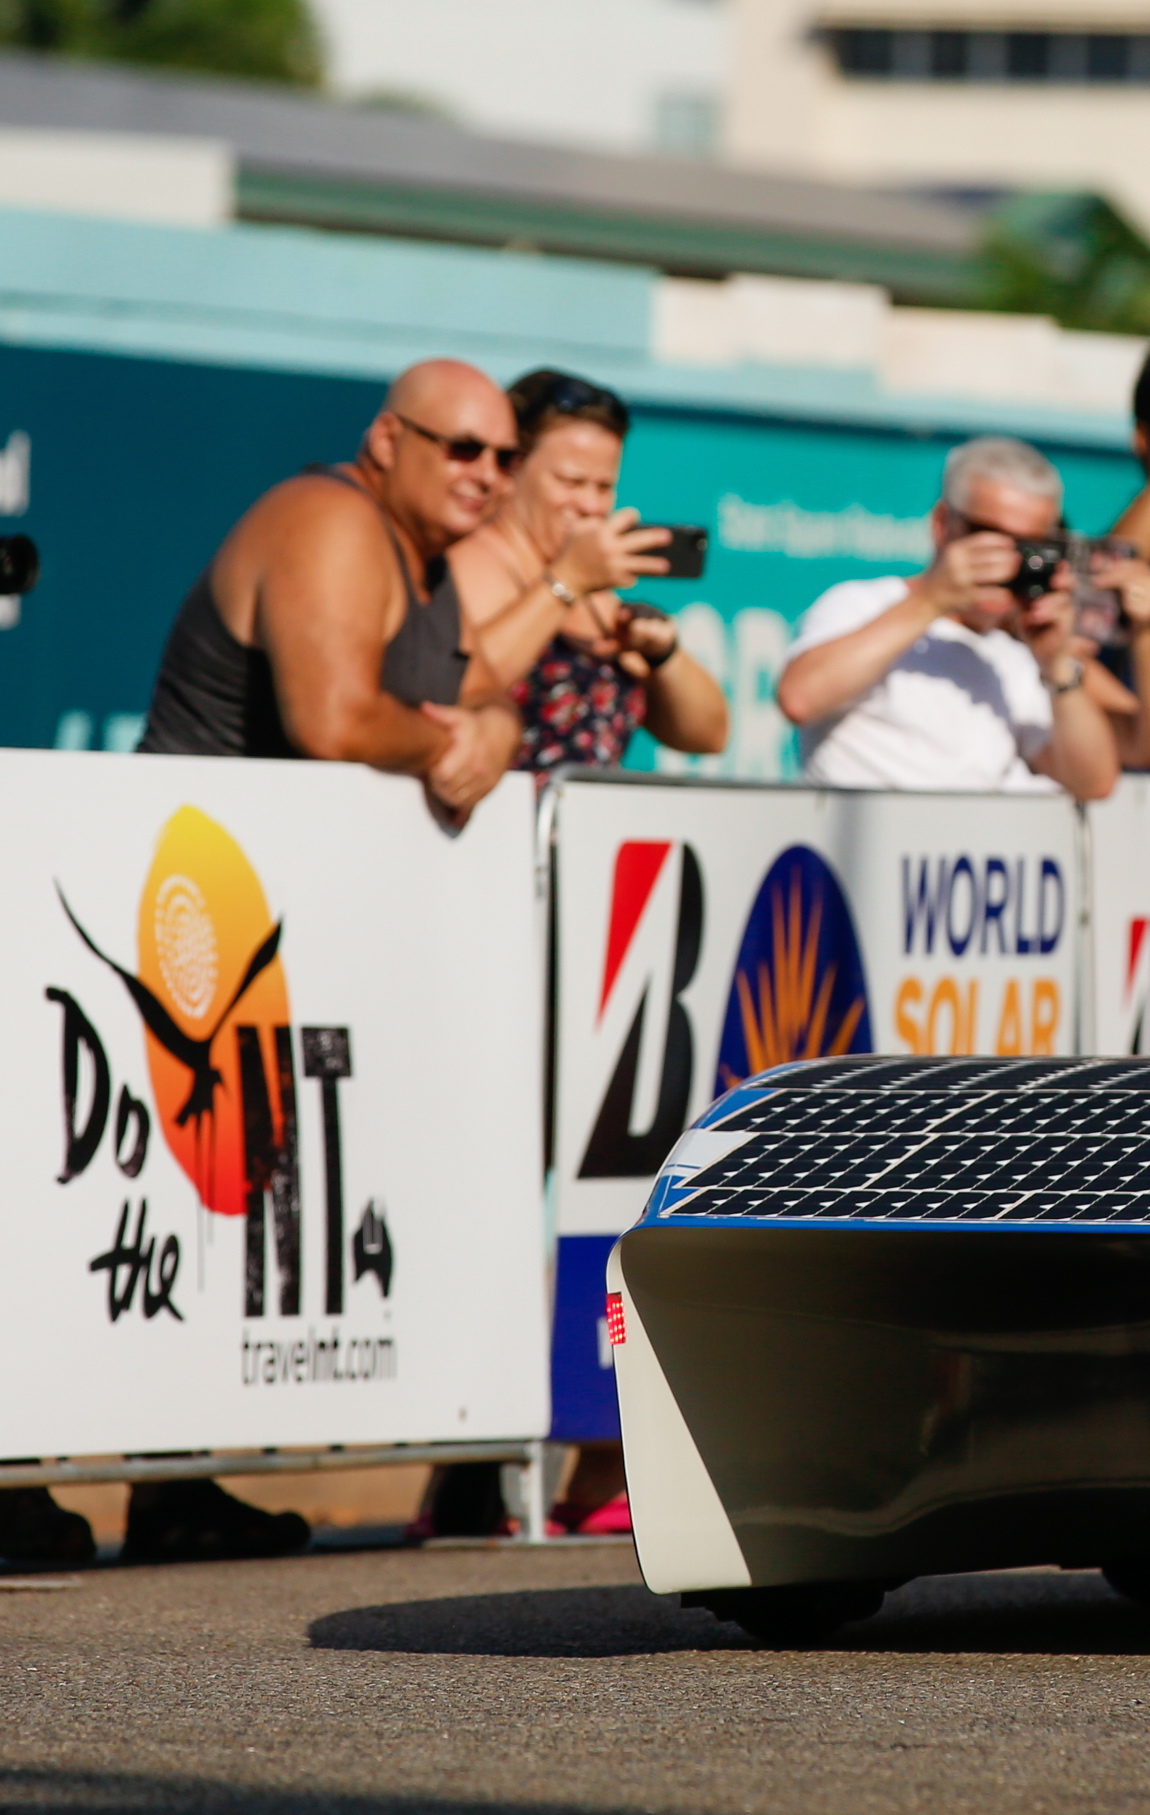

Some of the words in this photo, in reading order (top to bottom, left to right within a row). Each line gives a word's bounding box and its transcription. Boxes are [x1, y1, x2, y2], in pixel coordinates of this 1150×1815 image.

[902, 856, 1064, 957] WORLD
[894, 976, 1062, 1057] SOLAR
[45, 985, 151, 1185] Do
[89, 1197, 185, 1323] the
